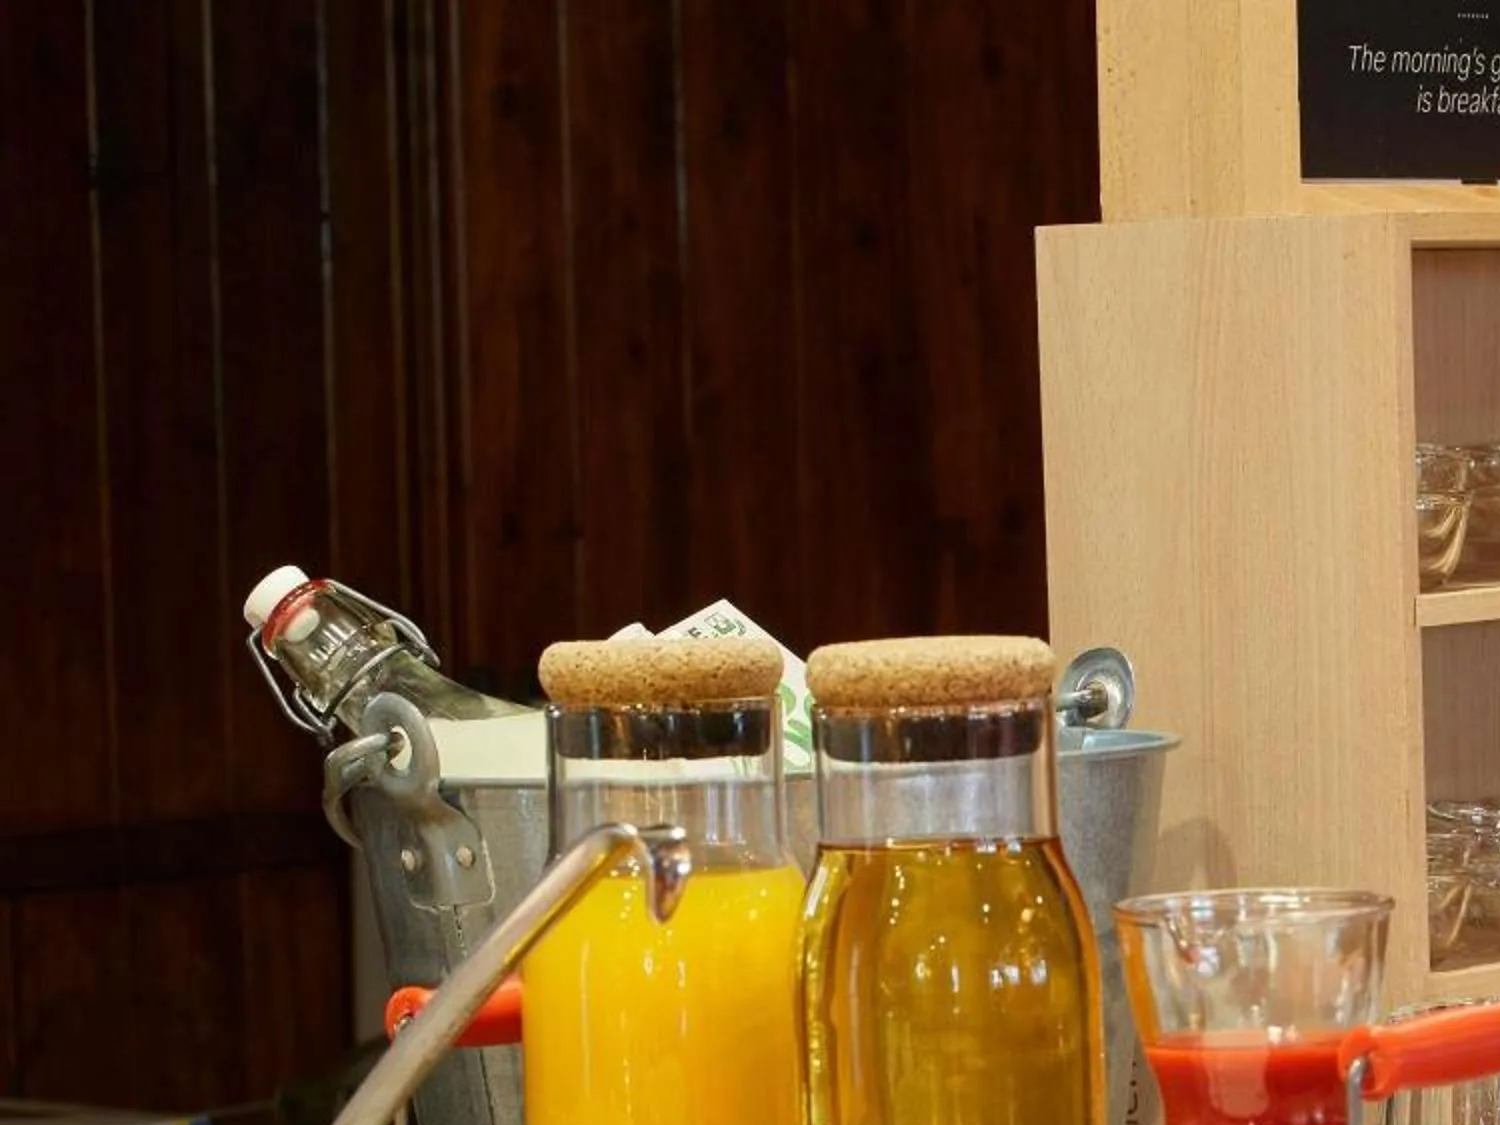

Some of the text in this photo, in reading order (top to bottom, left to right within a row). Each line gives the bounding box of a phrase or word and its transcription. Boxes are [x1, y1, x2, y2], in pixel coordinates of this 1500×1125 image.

[1349, 43, 1387, 72] The
[1391, 45, 1486, 81] morning's
[1416, 84, 1433, 113] is
